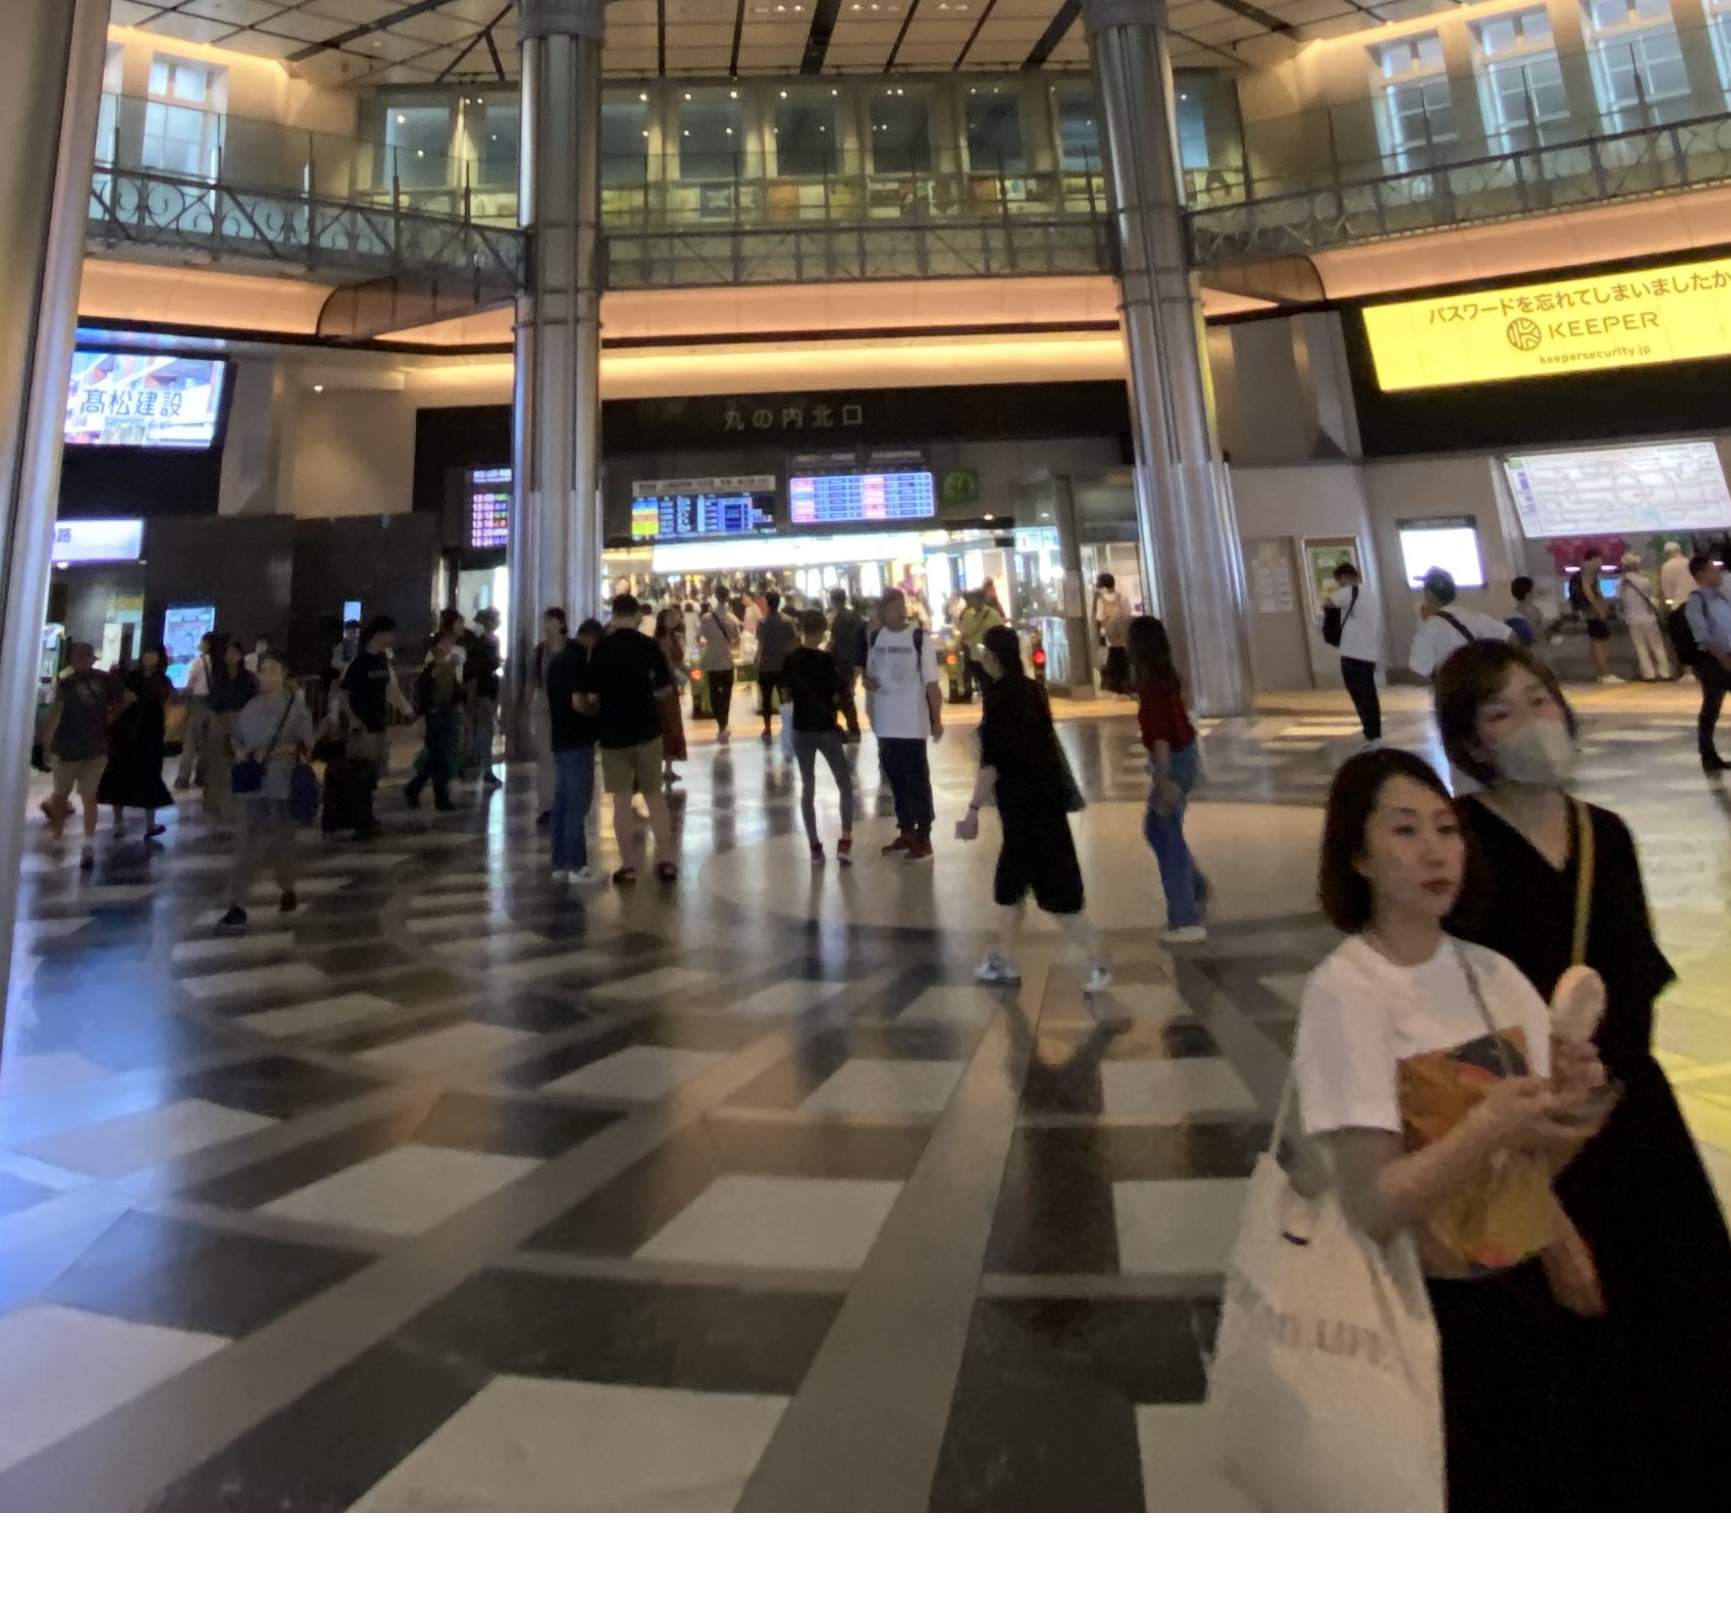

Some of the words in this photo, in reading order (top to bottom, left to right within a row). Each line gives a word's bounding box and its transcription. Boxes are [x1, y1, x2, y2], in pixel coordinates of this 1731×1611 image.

[1549, 311, 1660, 340] KEEPER
[1539, 343, 1651, 365] keepersecurity.jp
[723, 403, 863, 432] 丸の内北口
